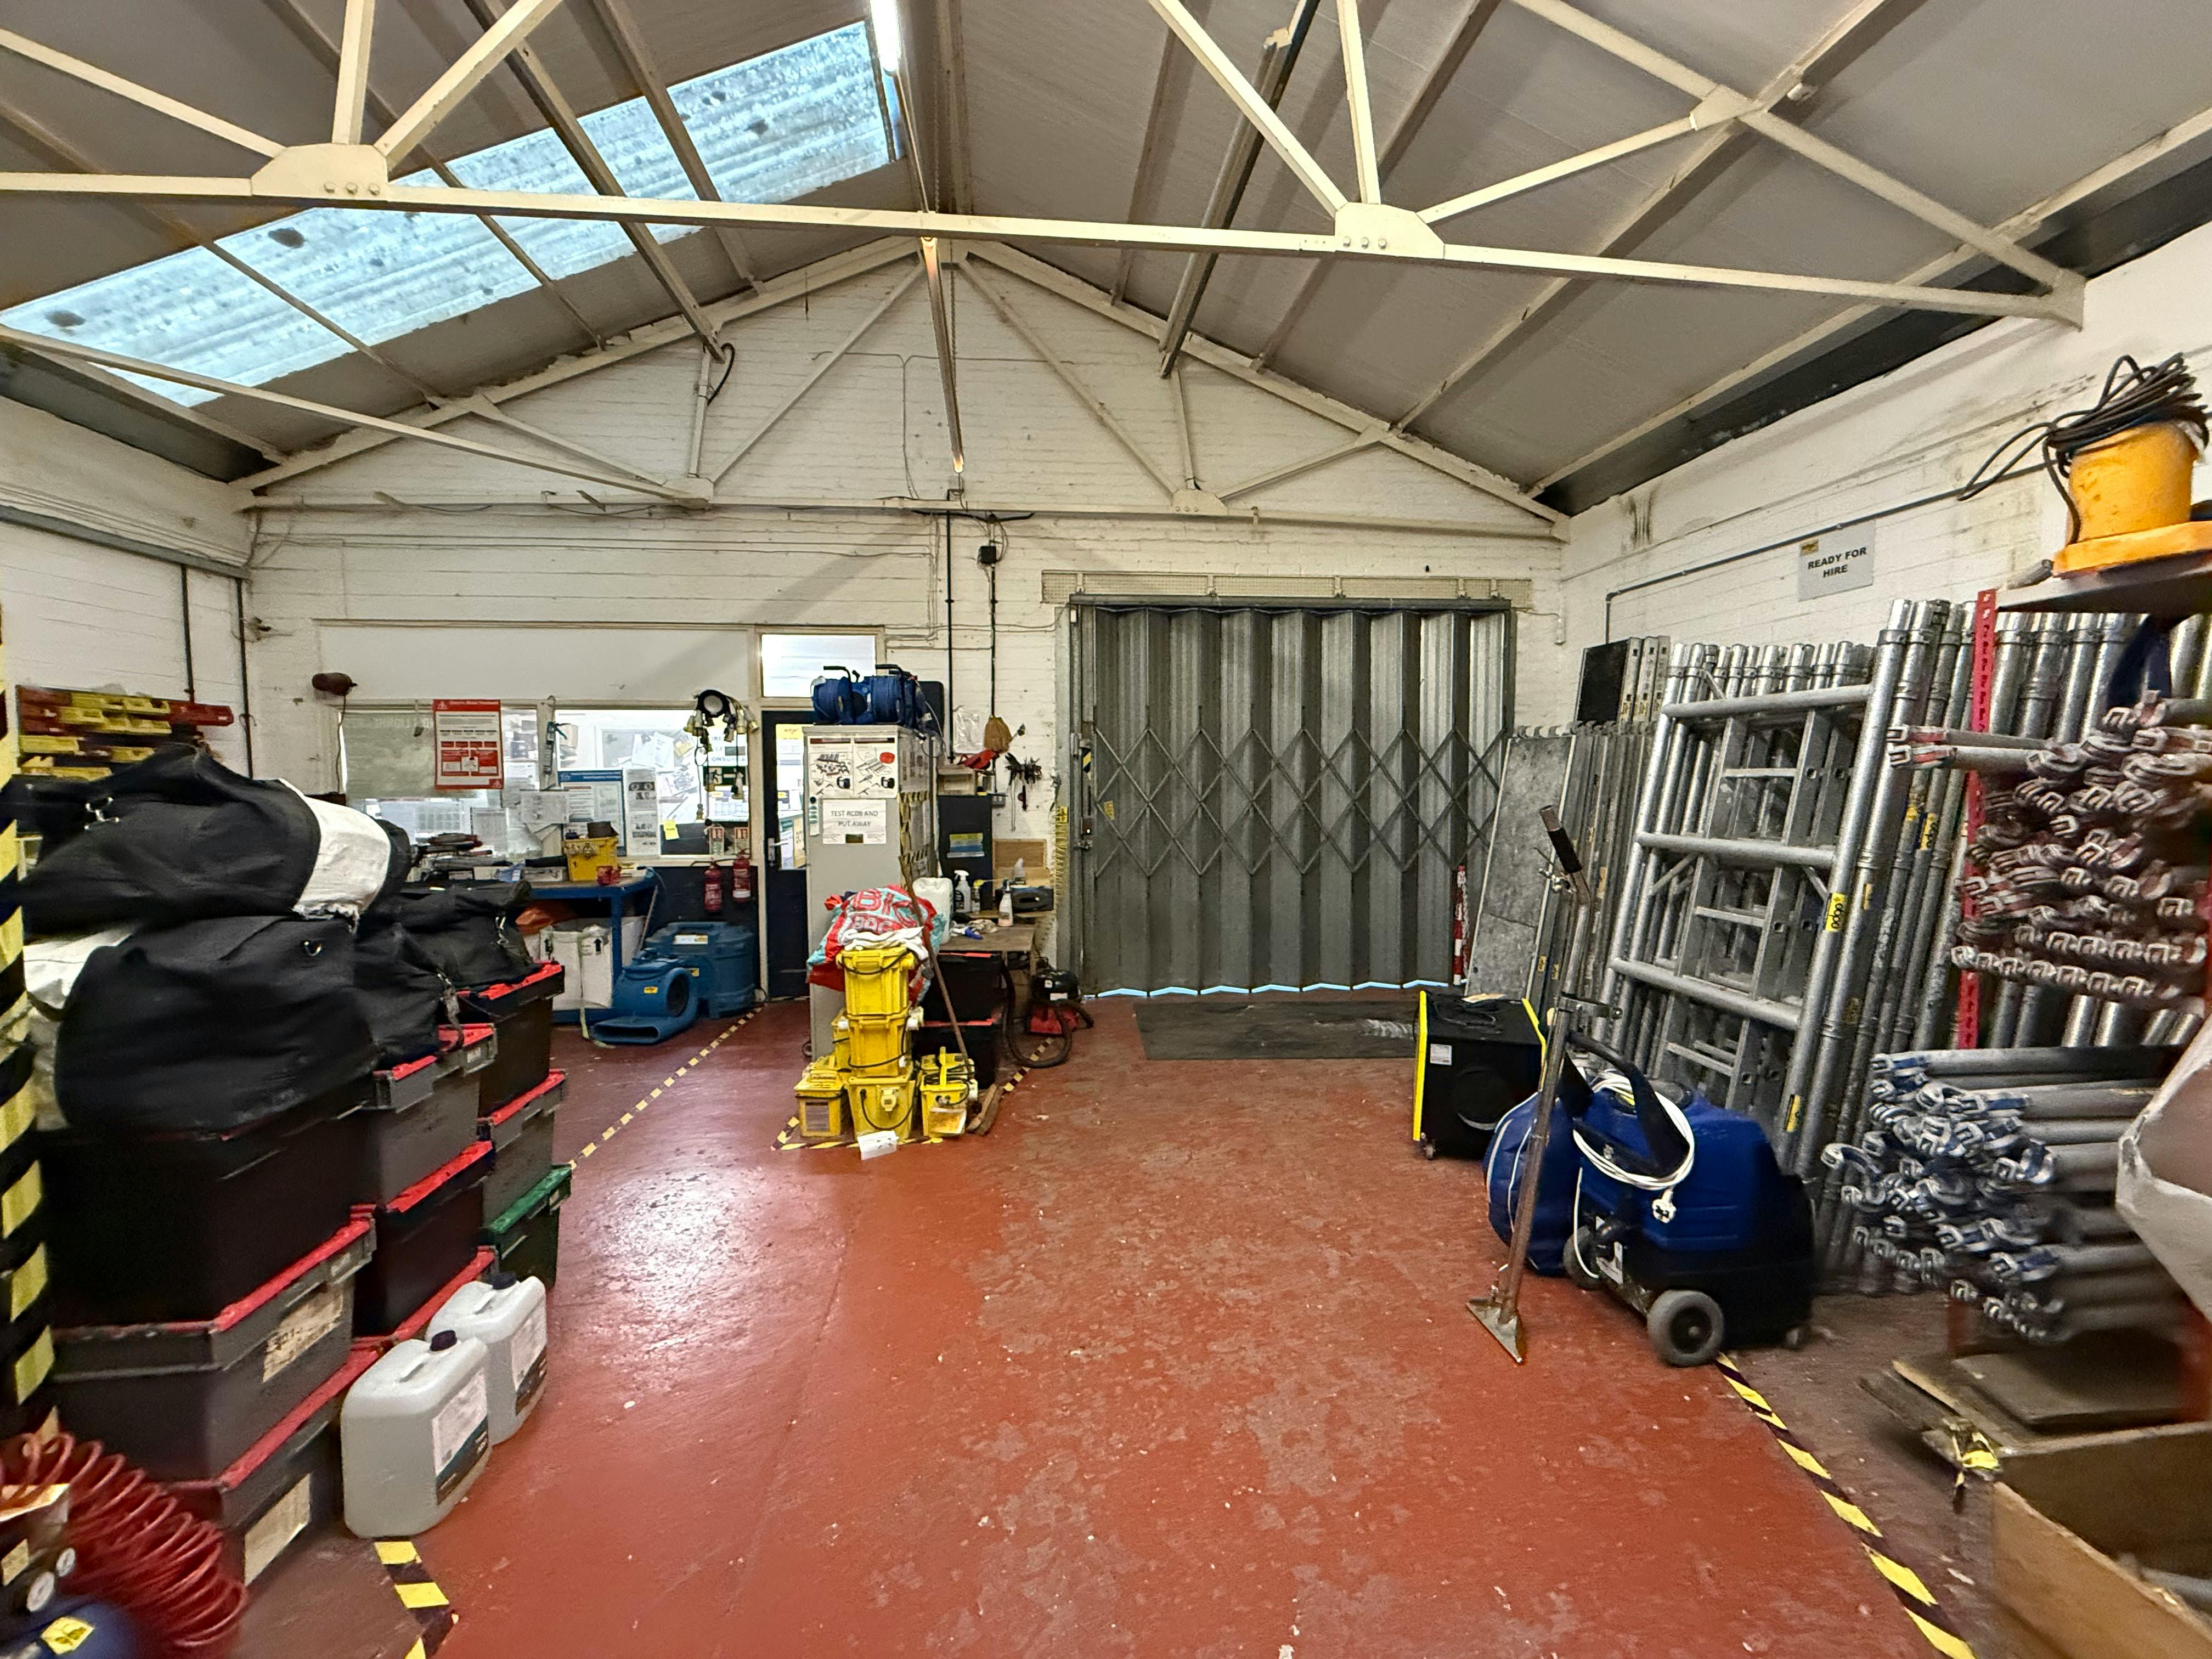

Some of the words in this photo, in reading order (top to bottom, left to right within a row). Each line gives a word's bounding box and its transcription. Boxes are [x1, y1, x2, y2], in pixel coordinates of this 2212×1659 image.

[1808, 554, 1842, 569] READY
[1845, 547, 1867, 560] FOR
[1822, 565, 1848, 578] HIRE
